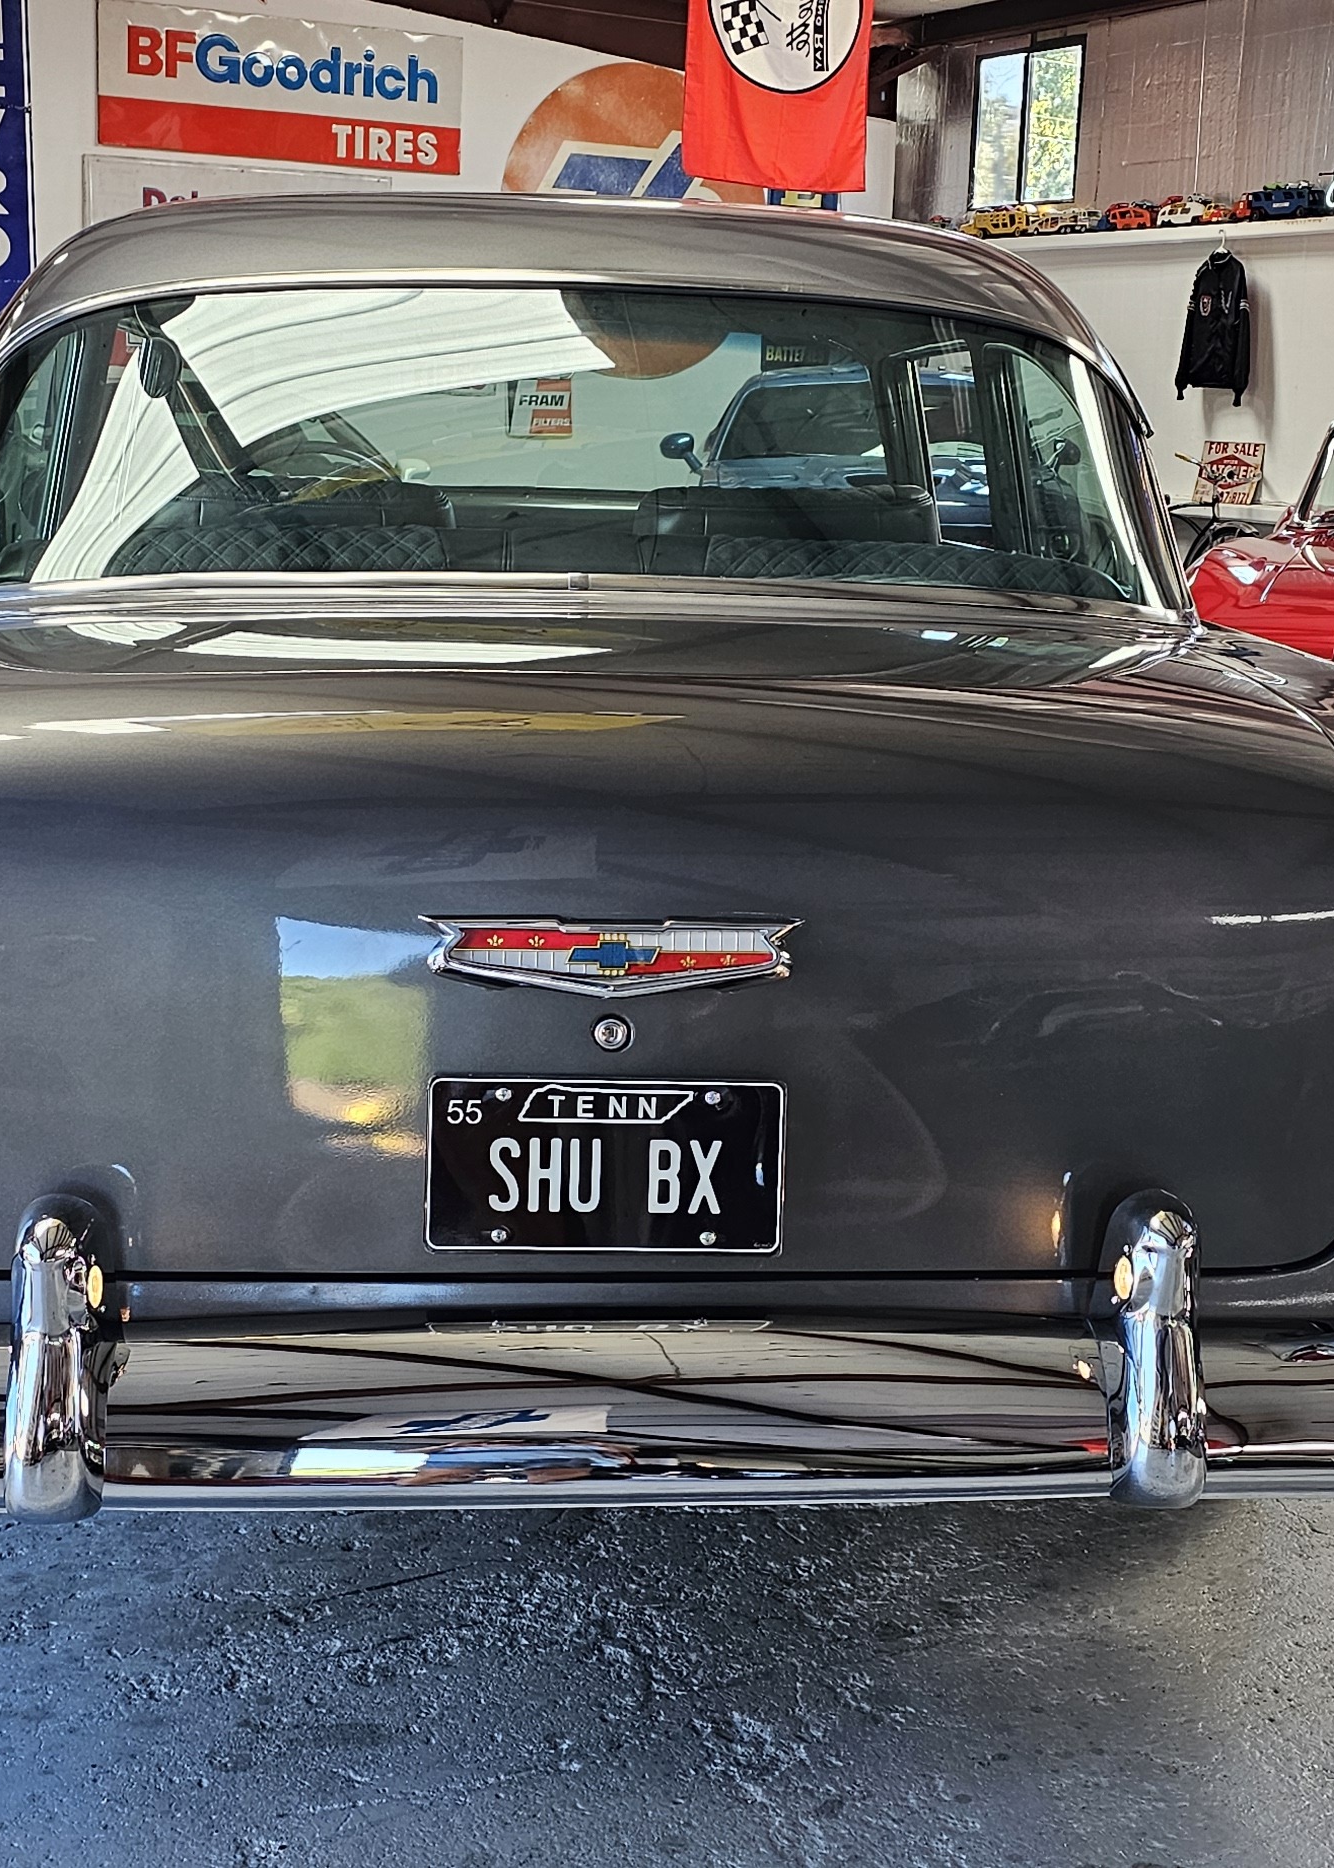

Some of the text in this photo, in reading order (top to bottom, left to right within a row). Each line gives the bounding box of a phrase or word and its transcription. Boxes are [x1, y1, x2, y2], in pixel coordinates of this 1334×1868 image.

[127, 25, 438, 104] BFGoodrich
[332, 124, 438, 165] TIRES
[518, 395, 565, 407] FRAM
[532, 418, 571, 427] FILTERS
[1208, 443, 1260, 457] FOR SALE
[447, 1094, 658, 1125] 55 TENN
[487, 1137, 723, 1214] SHU BX
